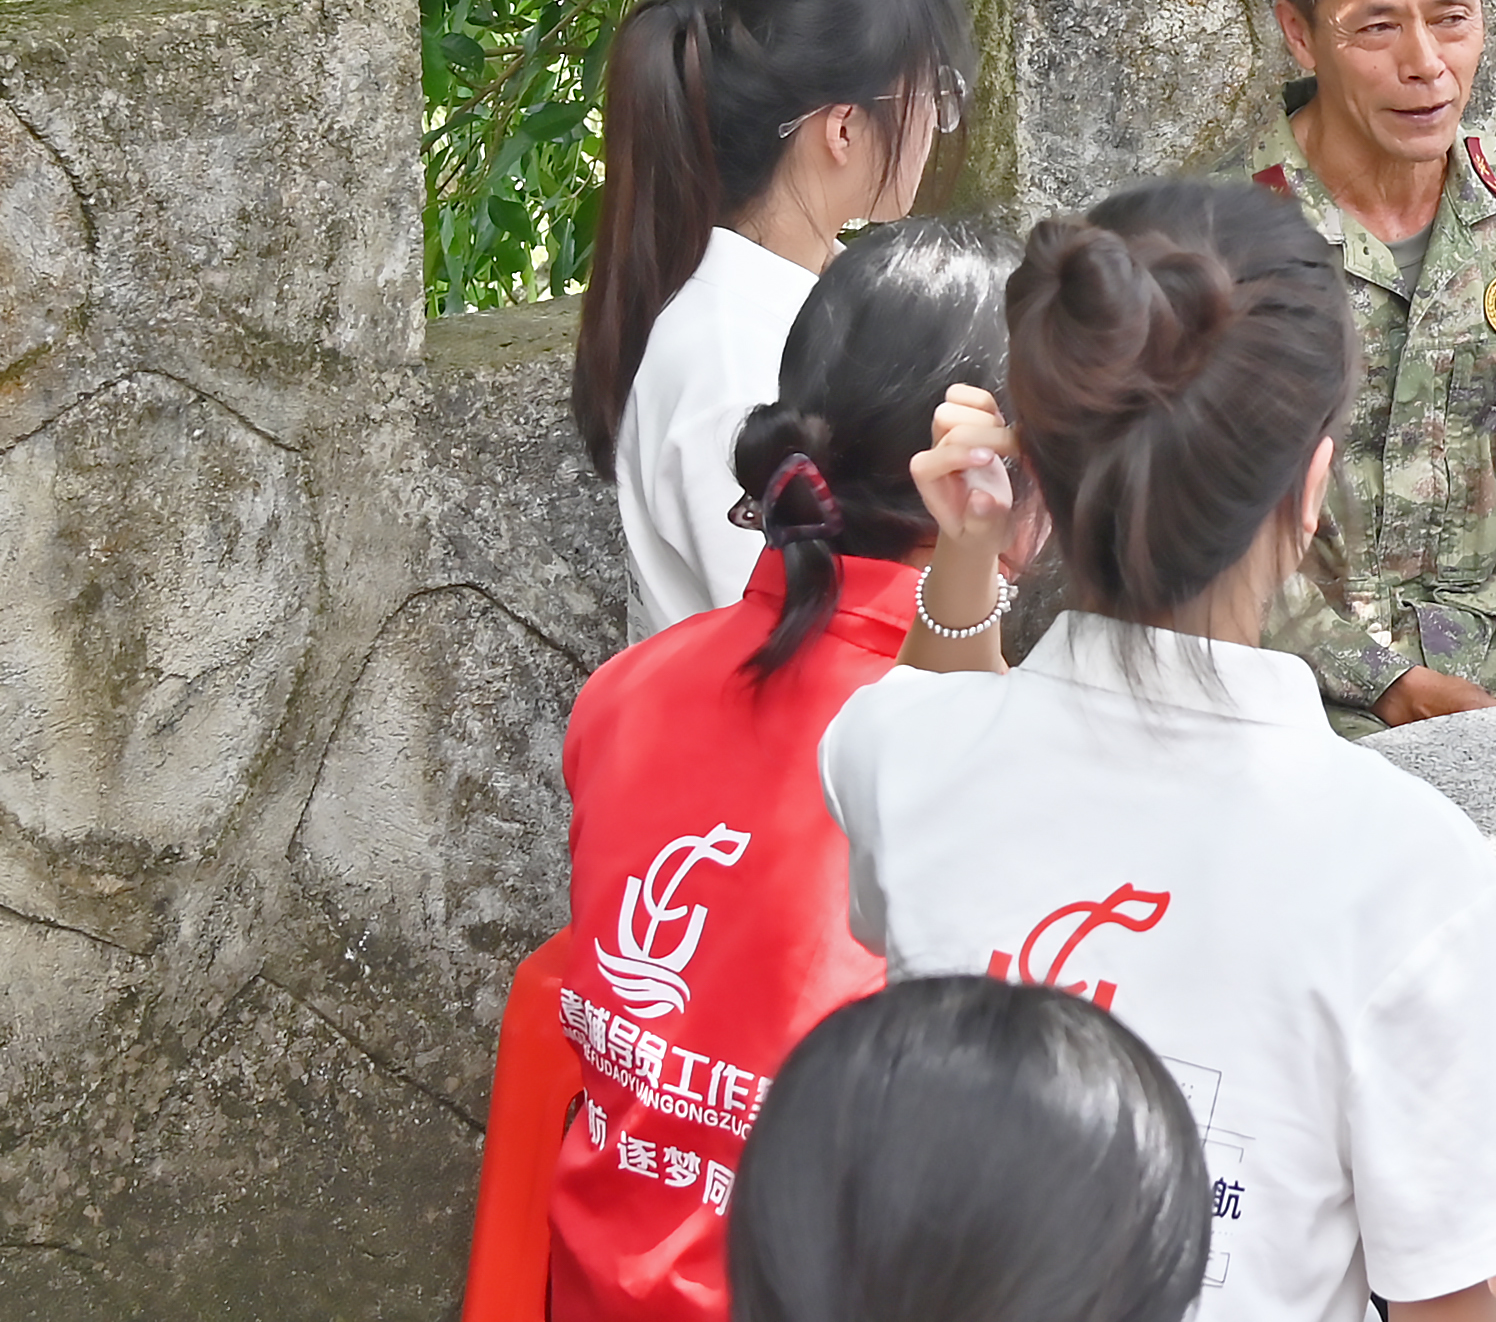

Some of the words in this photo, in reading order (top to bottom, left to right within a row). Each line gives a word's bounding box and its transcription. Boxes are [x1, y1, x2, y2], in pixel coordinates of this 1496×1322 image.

[559, 987, 774, 1121] 者辅导员工作
